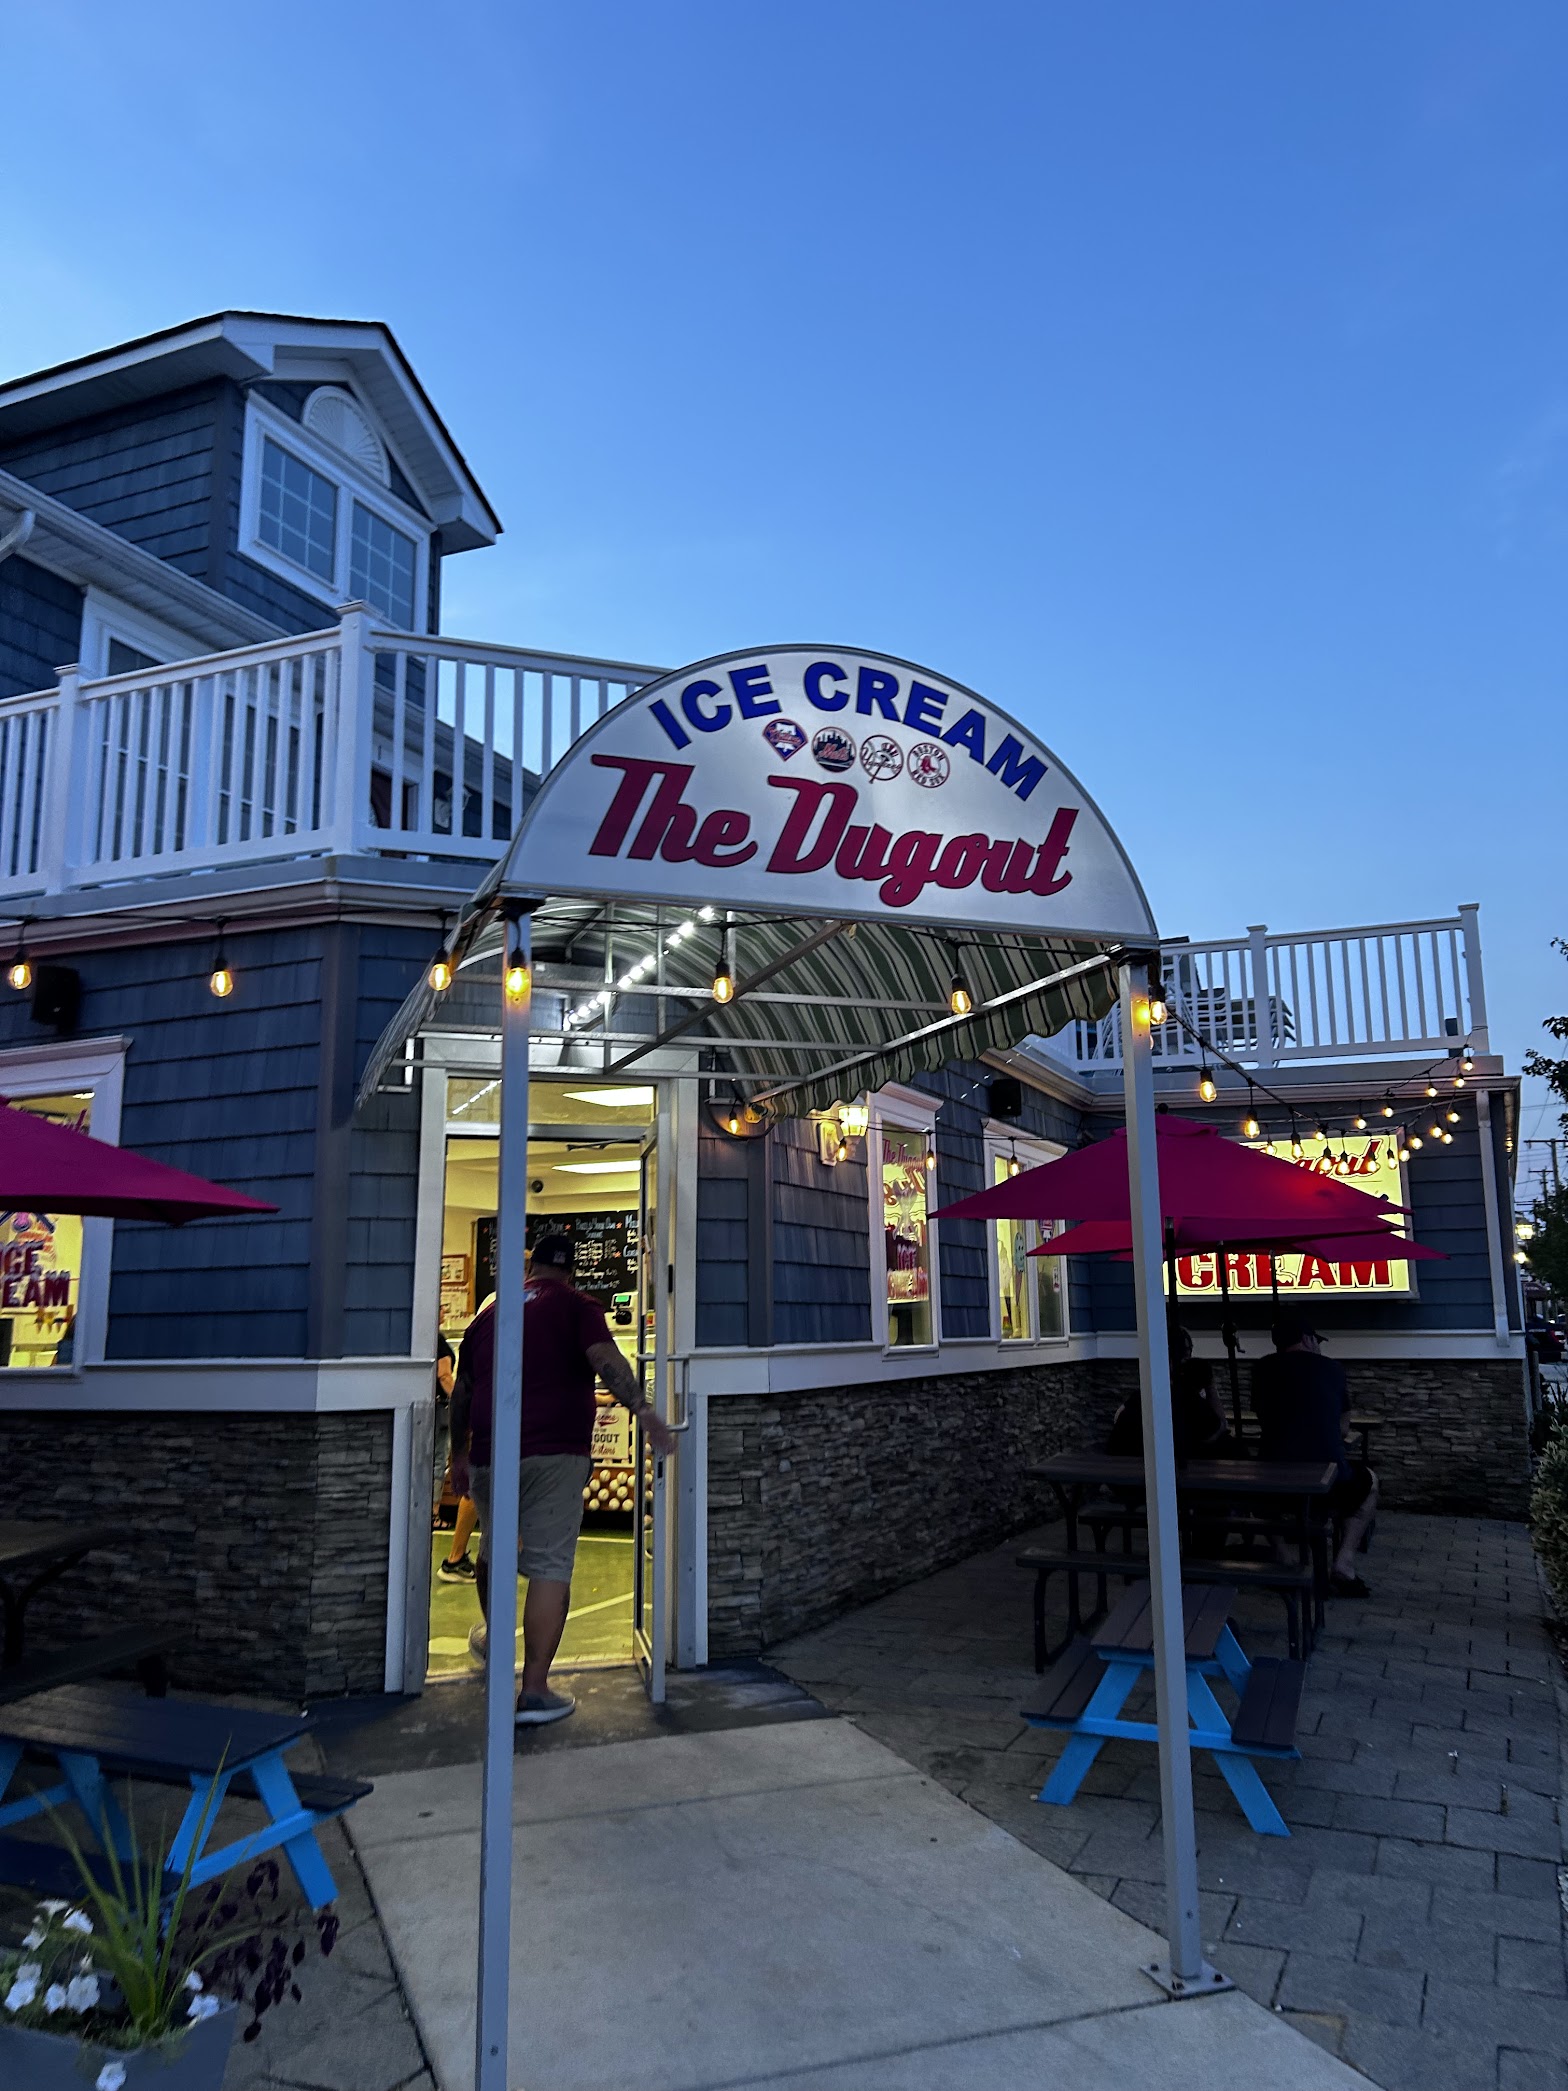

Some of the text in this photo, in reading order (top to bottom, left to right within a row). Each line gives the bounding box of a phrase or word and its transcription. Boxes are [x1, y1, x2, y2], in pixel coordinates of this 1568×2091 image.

[648, 660, 1049, 802] ICE CREAM
[911, 744, 946, 761] BOSTON
[588, 753, 1080, 908] The Dugout
[1177, 1253, 1391, 1288] CREAM
